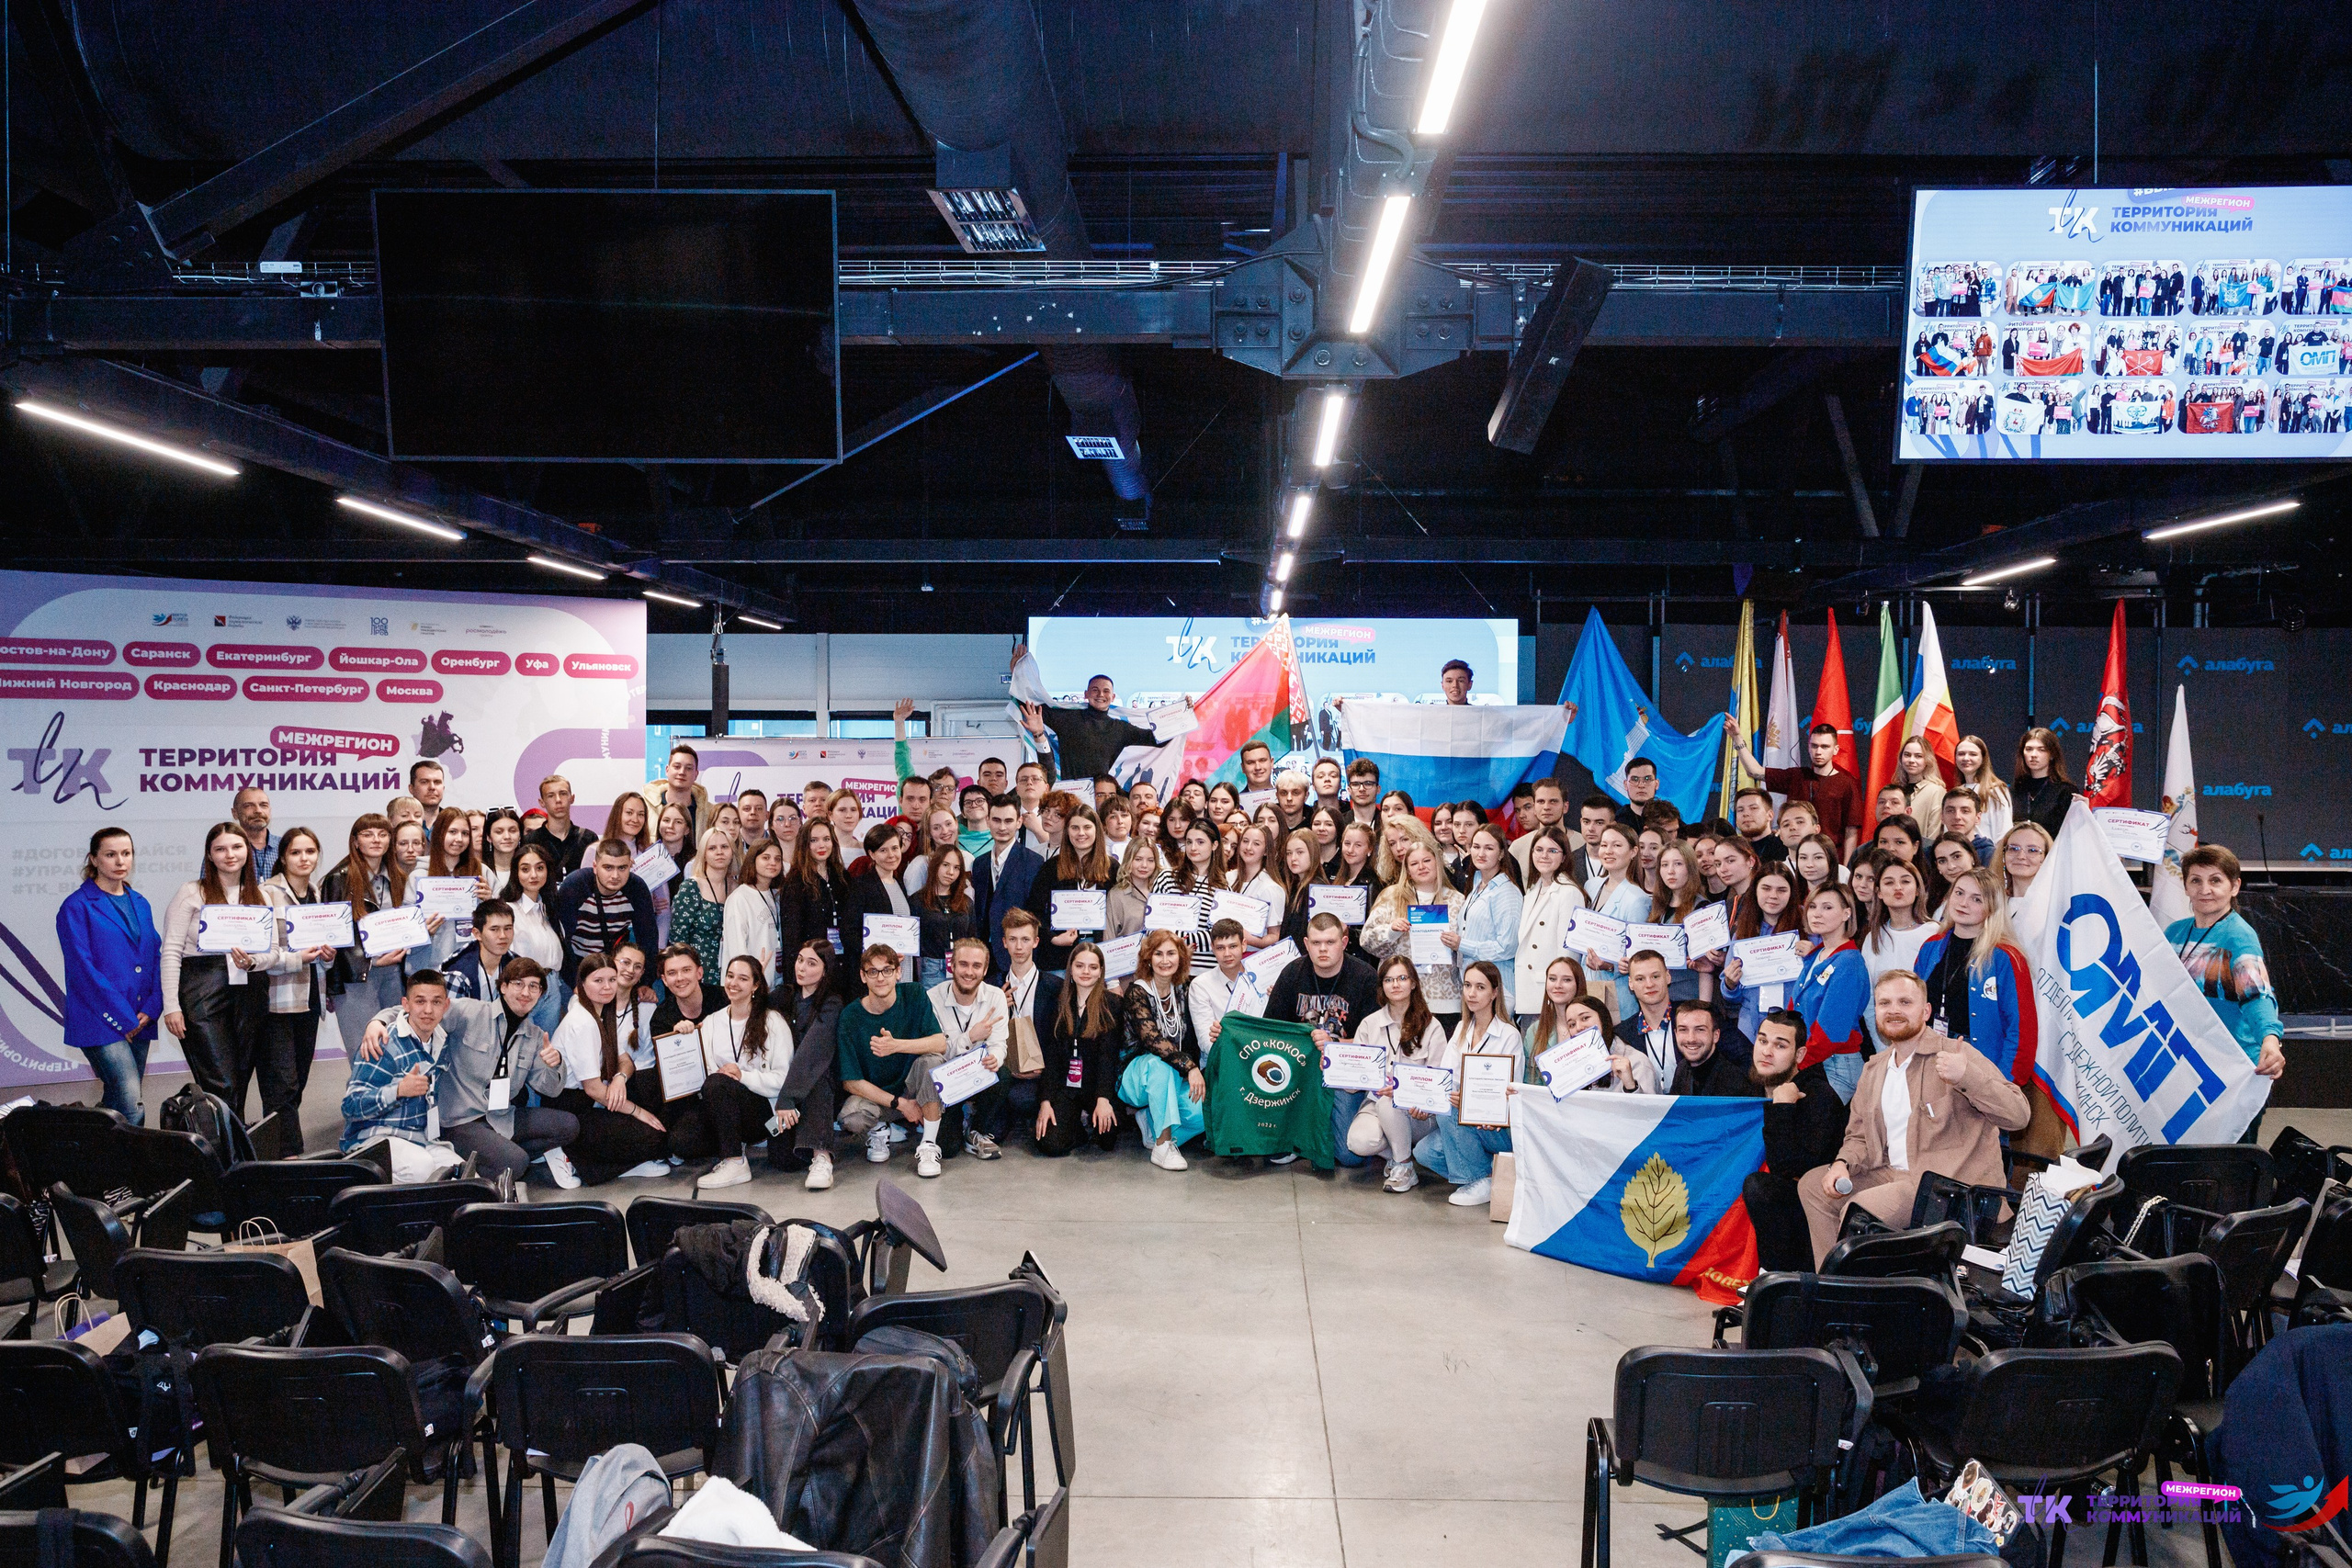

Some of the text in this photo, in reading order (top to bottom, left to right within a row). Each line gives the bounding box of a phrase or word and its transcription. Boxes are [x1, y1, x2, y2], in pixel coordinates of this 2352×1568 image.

[2185, 195, 2251, 208] МЕЖРЕГИОН
[2111, 206, 2218, 219] ТЕРРИТОРИЯ
[2109, 217, 2254, 233] КОММУНИКАЦИЙ
[2301, 350, 2336, 366] ОМП
[370, 616, 389, 626] 100
[1304, 626, 1372, 639] МЕЖРЕГИОН
[1230, 636, 1339, 649] ТЕРОРИЯ
[0, 645, 110, 660] остов-на-Дону
[130, 648, 191, 660] Саранск
[216, 650, 312, 665] Екатеринбург
[1230, 649, 1376, 665] КНИКАЦИЙ
[339, 652, 419, 667] Йошкар-Ола
[440, 657, 500, 669] Оренбург
[525, 659, 549, 671] Уфа
[571, 660, 632, 671] Ульяновск
[1951, 655, 2017, 671] алабуга
[2204, 657, 2275, 675] алабуга
[0, 678, 132, 692] ижний Новгород
[153, 681, 231, 693] Краснодар
[249, 682, 364, 694] Санкт-Петербург
[386, 686, 434, 696] Москва
[277, 730, 393, 751] МЕЖРЕГИОН
[139, 748, 337, 768] ТЕРРИТОРИЯ
[139, 767, 401, 793] КОММУНИКАЦИЙ
[844, 781, 897, 793] МЕЖРЕГИО
[2202, 782, 2273, 800] алабуга
[2108, 818, 2150, 828] СЕРТИФИКАТ
[1584, 920, 1618, 933] СЕРТИФИКАТ
[1690, 916, 1714, 929] СЕРТИФИКАТ
[1106, 942, 1136, 954] СЕРТИФИКАТ
[1749, 944, 1785, 954] СЕРТИФИКАТ
[1259, 950, 1286, 966] СЕРТИФИКАТ
[2055, 893, 2227, 1145] ОМП
[1238, 1039, 1306, 1066] СПО «КОКОС»
[1554, 1042, 1587, 1064] СЕРТИФИКАТ
[946, 1059, 977, 1077] СЕРТИФИКАТ
[1409, 1075, 1433, 1083] ДИПЛОМ
[1243, 1088, 1301, 1110] Дзержинск
